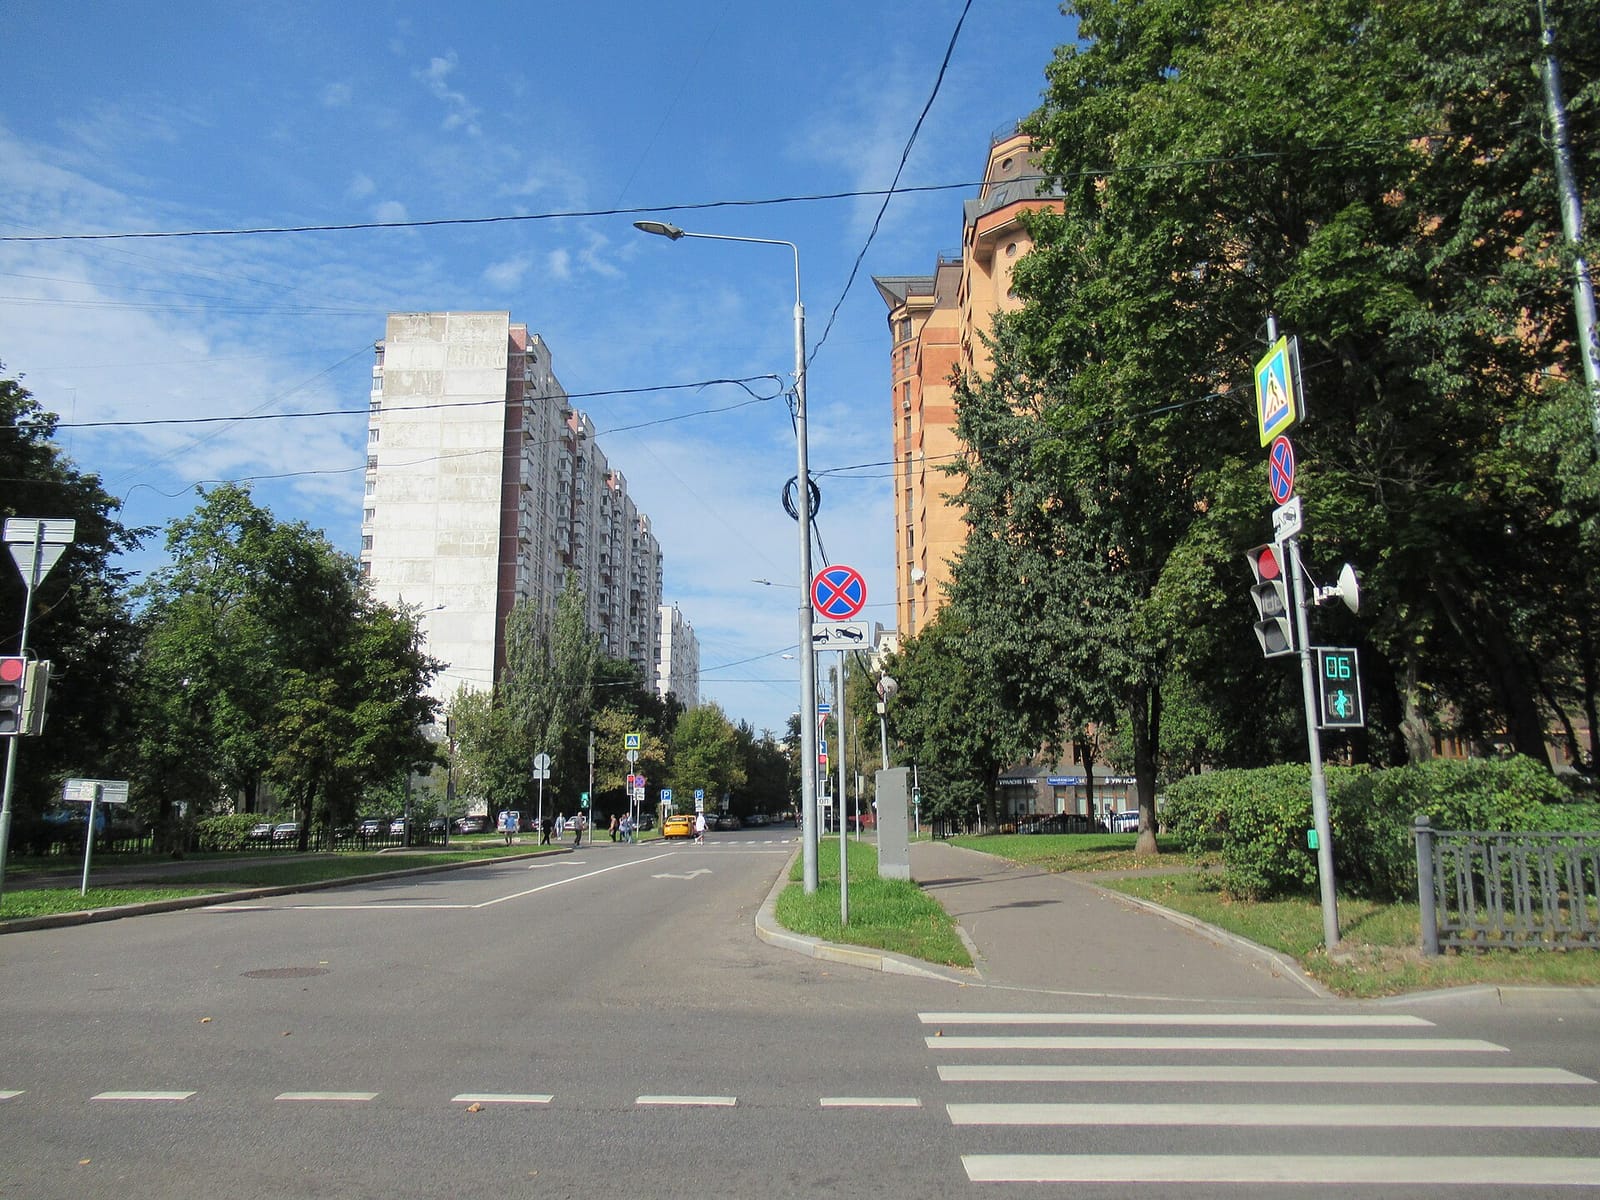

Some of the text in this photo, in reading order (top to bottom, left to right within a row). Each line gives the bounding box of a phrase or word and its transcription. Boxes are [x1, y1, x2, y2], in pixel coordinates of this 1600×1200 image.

[1325, 656, 1350, 678] 06
[664, 791, 670, 799] P
[697, 790, 702, 798] P
